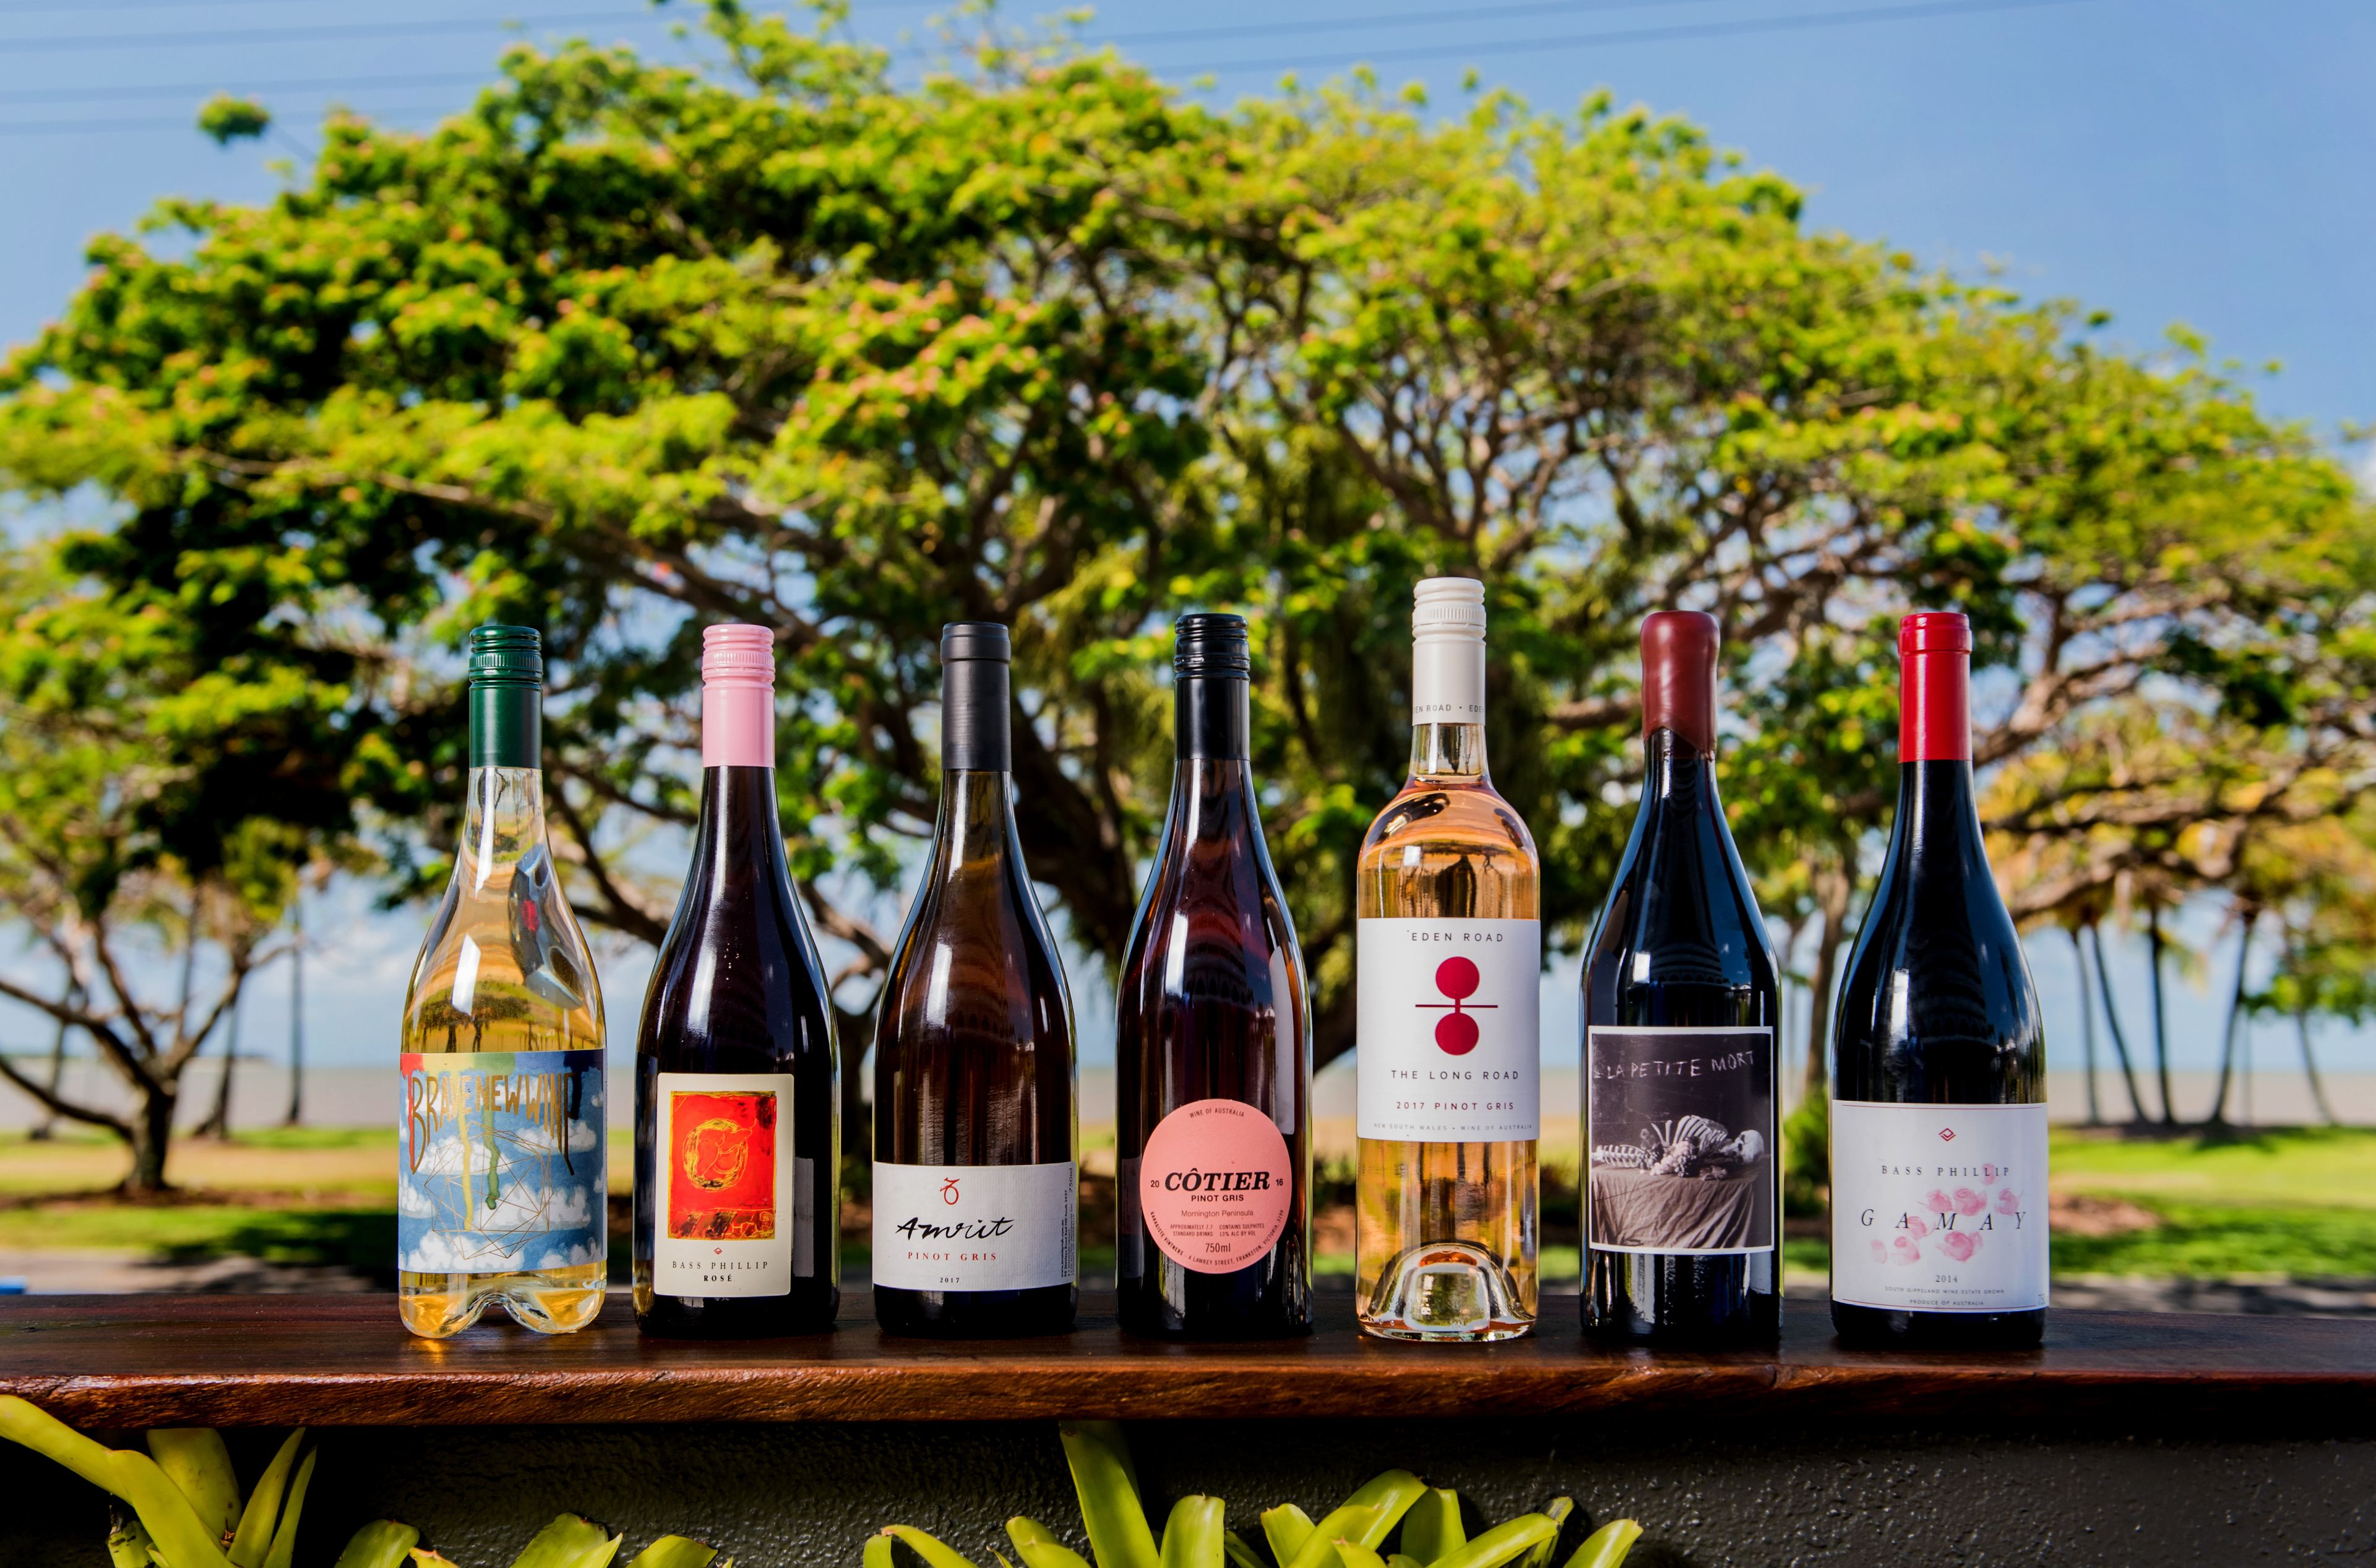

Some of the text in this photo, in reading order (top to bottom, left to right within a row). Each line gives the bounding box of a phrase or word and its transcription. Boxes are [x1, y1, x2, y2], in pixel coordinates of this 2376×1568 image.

[1426, 704, 1452, 712] ROAD
[1411, 933, 1504, 942] EDEN ROAD
[1607, 1050, 1754, 1080] LA PETITE MORT
[1391, 1069, 1519, 1080] THE LONG ROAD
[1397, 1101, 1514, 1110] 2017 PINOT GRIS
[1189, 1109, 1203, 1118] WINE
[1215, 1108, 1244, 1117] AUSTRALIA
[411, 1072, 579, 1176] BRAVE NEW WINE
[1881, 1165, 2010, 1177] BASS PHILLIP
[1150, 1168, 1284, 1191] 20 CÔTIER 16
[1181, 1209, 1254, 1218] Mornington Peninsula
[1861, 1208, 2026, 1231] GAMAY
[1164, 1236, 1184, 1256] VINTNERS
[1192, 1257, 1213, 1265] LAWREY
[1205, 1243, 1231, 1253] 750ml
[908, 1252, 997, 1261] PINOT GRIS
[672, 1260, 769, 1270] BASS PHILLIP
[703, 1273, 733, 1282] ROSÉ
[1935, 1275, 1958, 1283] 2014
